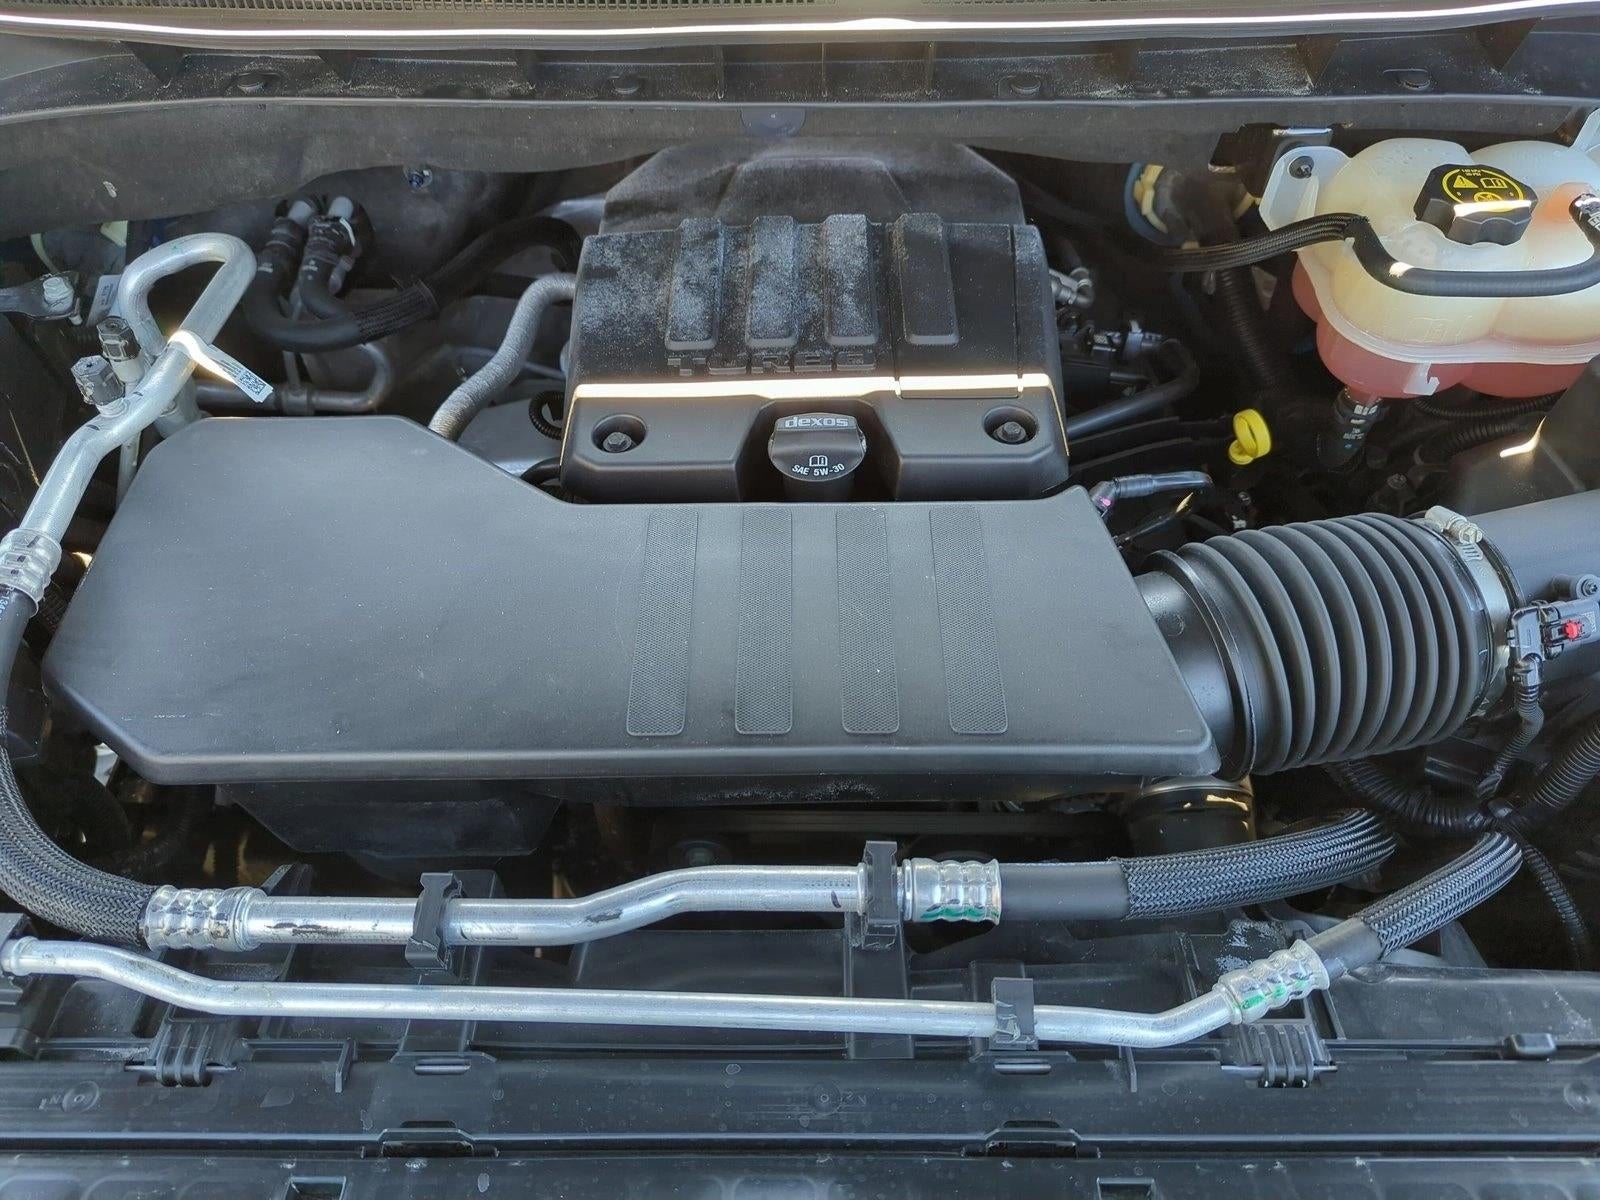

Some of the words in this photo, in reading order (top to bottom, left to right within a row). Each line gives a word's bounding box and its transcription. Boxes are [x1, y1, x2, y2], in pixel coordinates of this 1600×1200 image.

[785, 417, 848, 428] dexos
[792, 464, 810, 476] SAE
[813, 463, 845, 476] 5W-30
